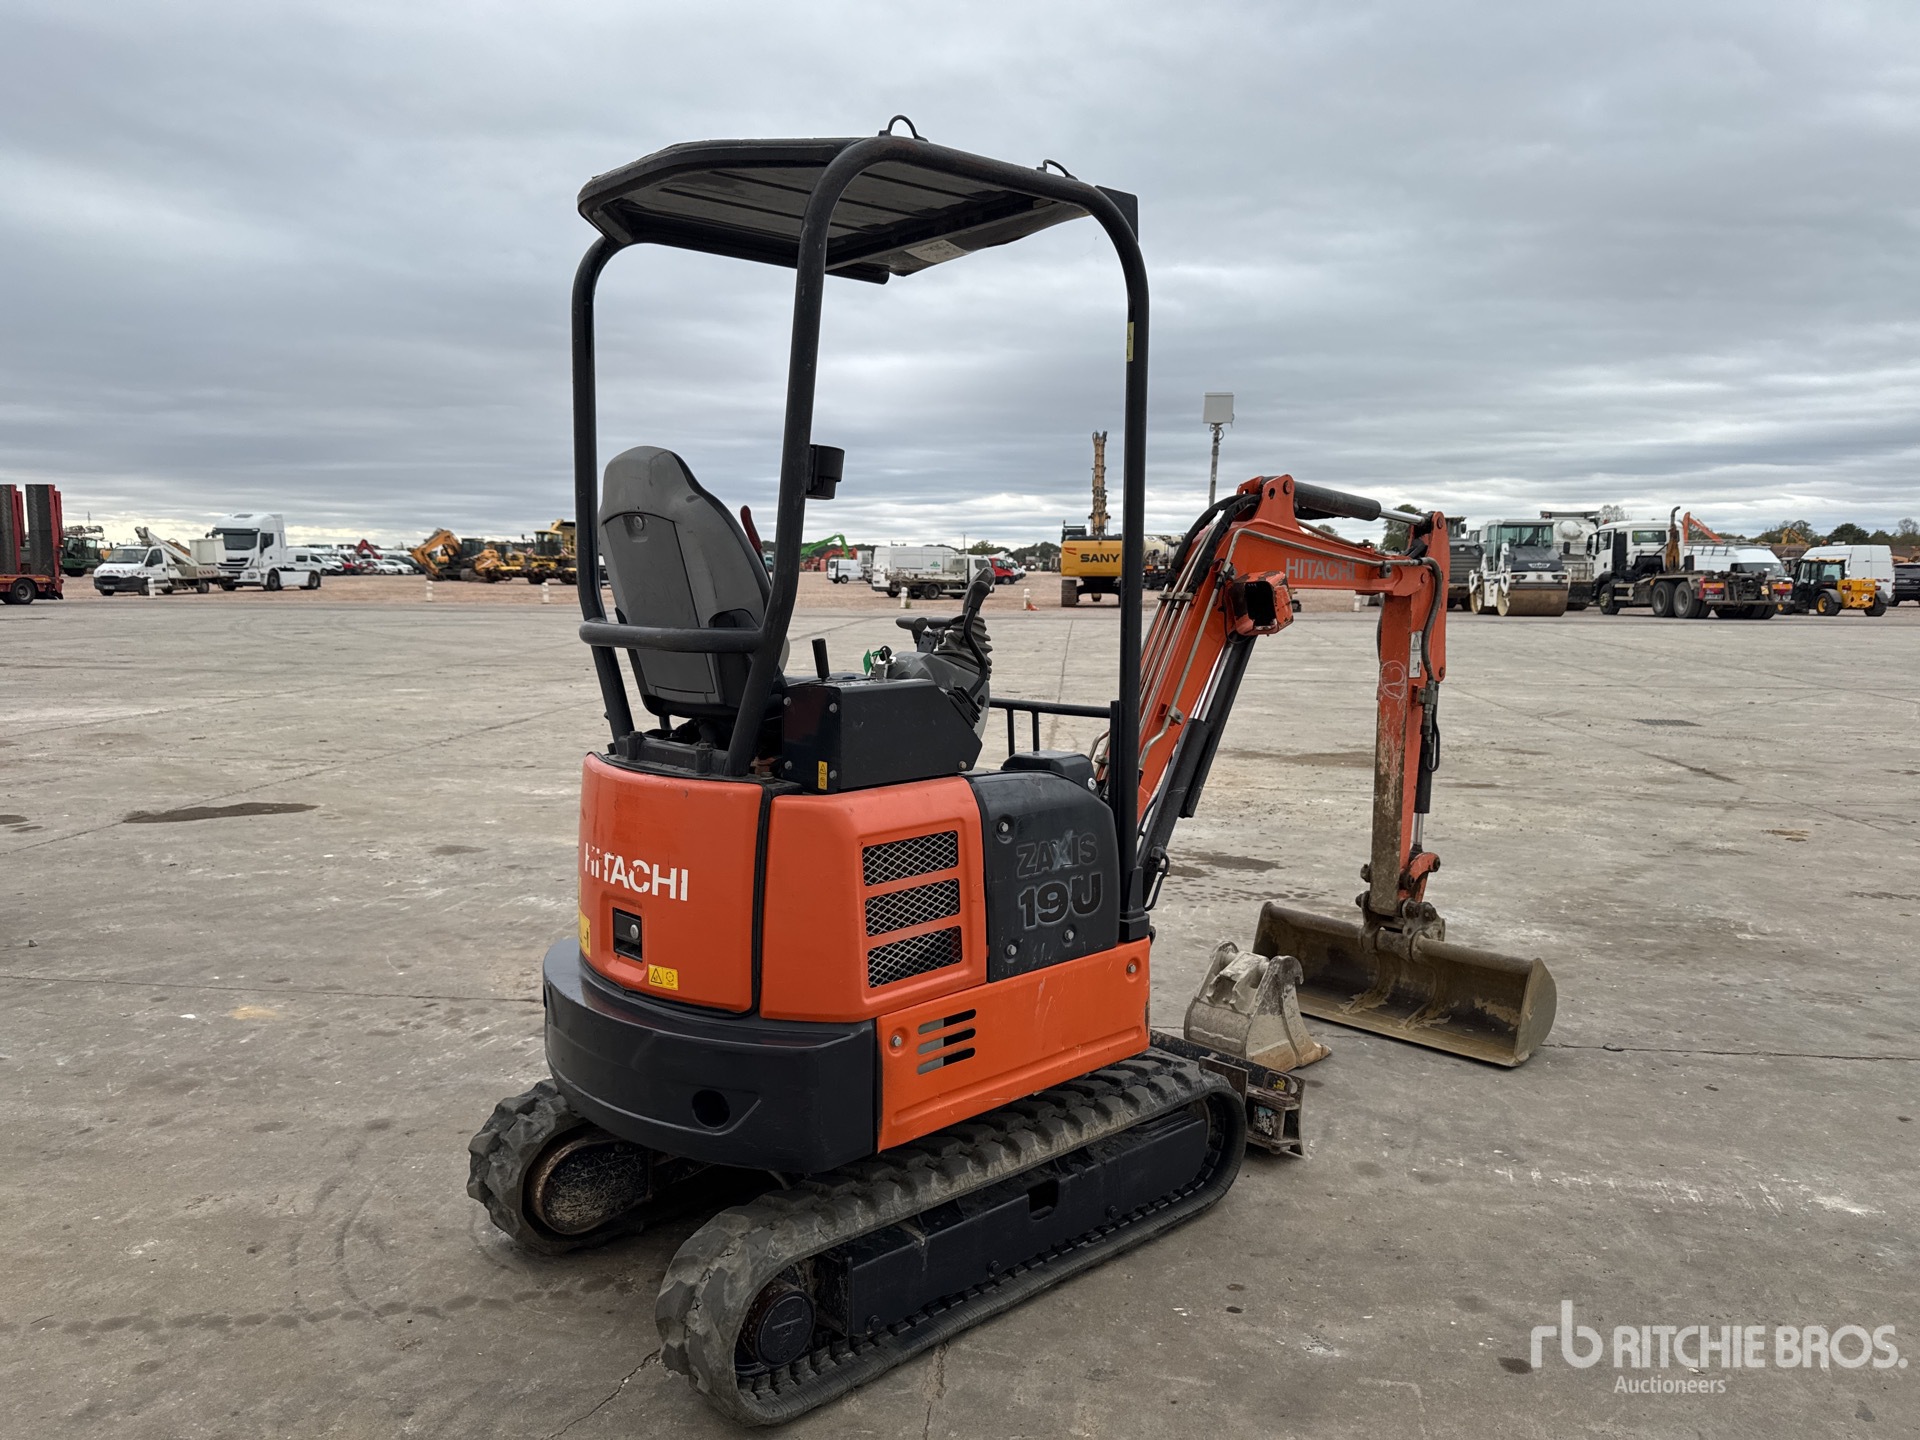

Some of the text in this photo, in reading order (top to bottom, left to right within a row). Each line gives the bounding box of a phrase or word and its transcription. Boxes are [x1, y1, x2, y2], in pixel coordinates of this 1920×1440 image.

[1080, 553, 1120, 563] SANY
[1285, 557, 1355, 581] HITACHI
[584, 842, 689, 901] HITACHI
[1017, 829, 1098, 878] ZAXIS
[1018, 873, 1103, 930] 19U
